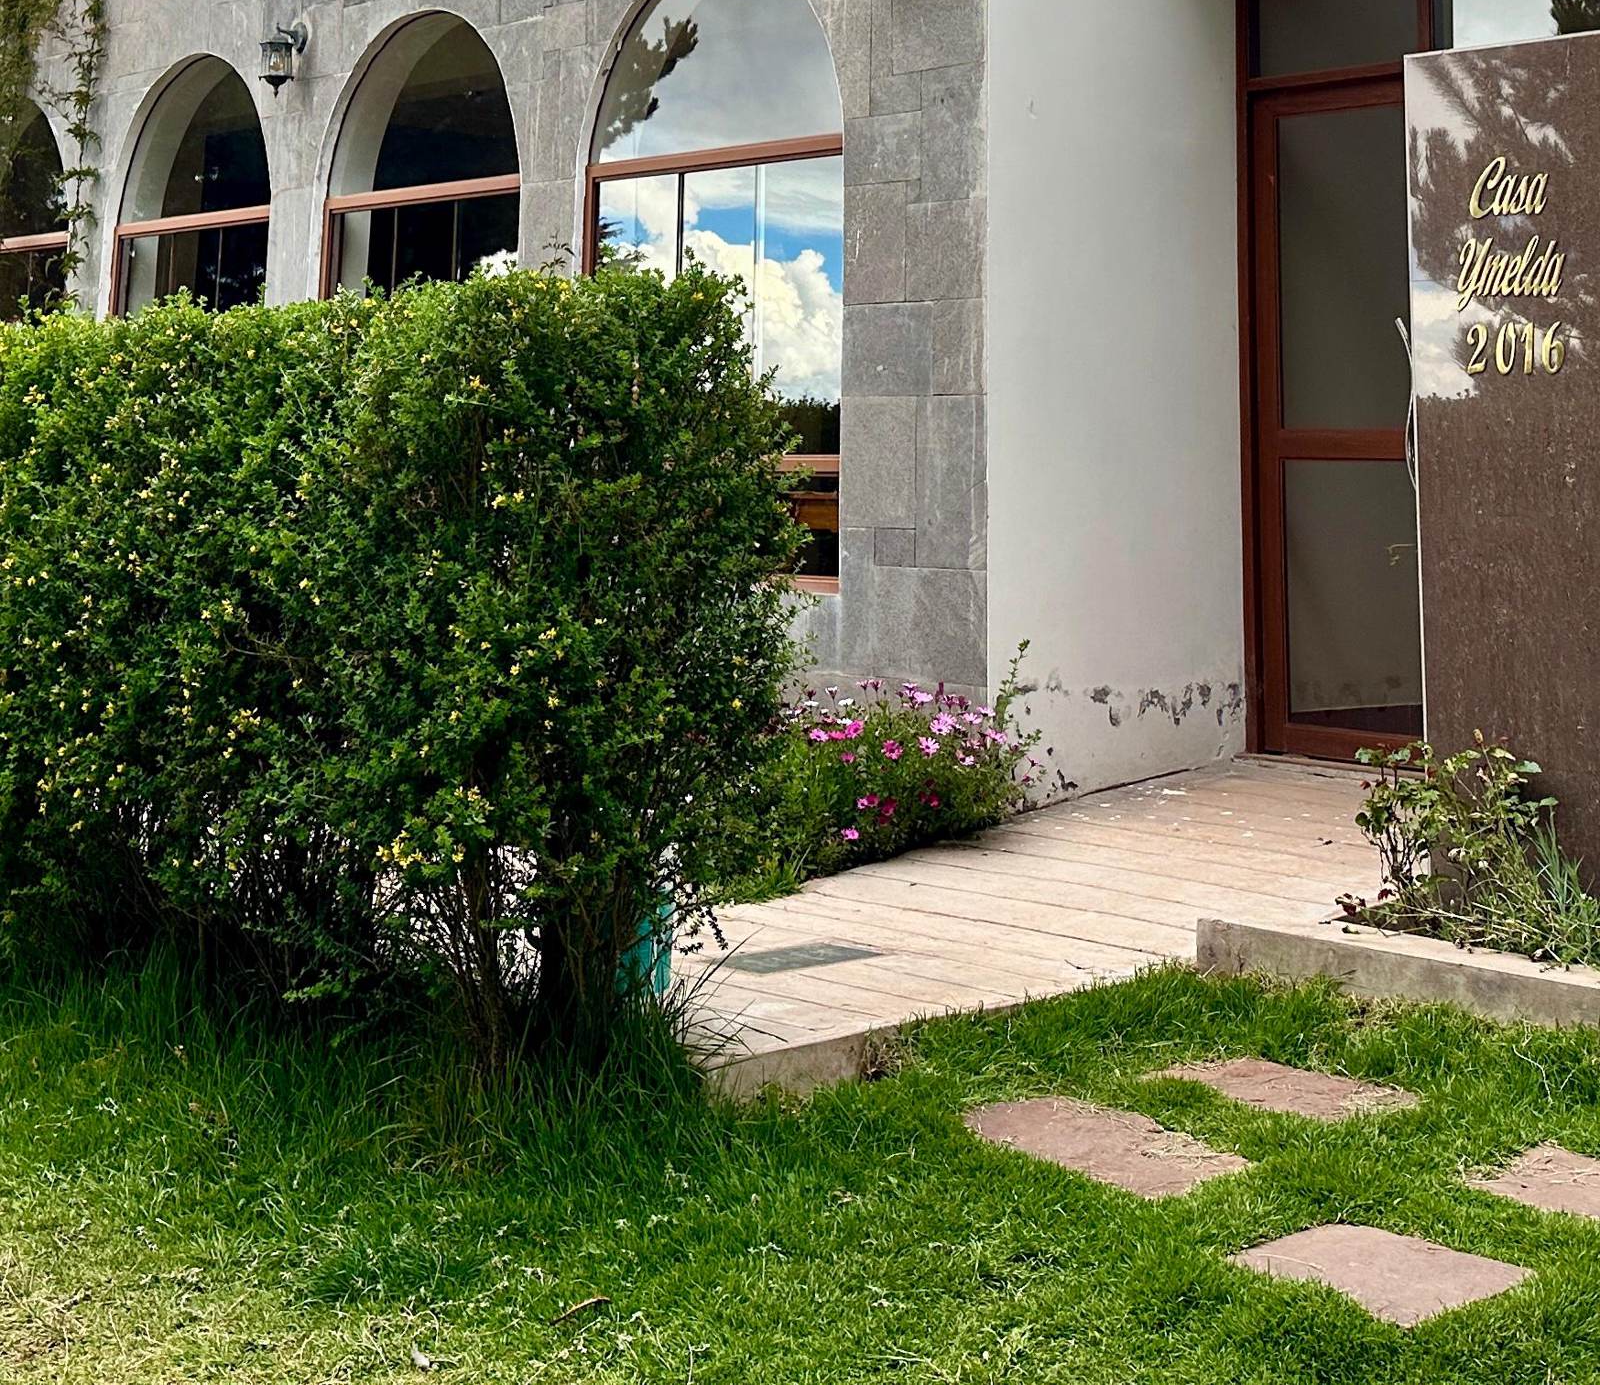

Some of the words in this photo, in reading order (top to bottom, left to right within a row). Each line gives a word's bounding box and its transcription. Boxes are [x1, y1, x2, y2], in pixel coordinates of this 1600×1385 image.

[1469, 156, 1549, 219] Casa
[1456, 234, 1566, 311] Ymelda
[1466, 320, 1566, 375] 2016
